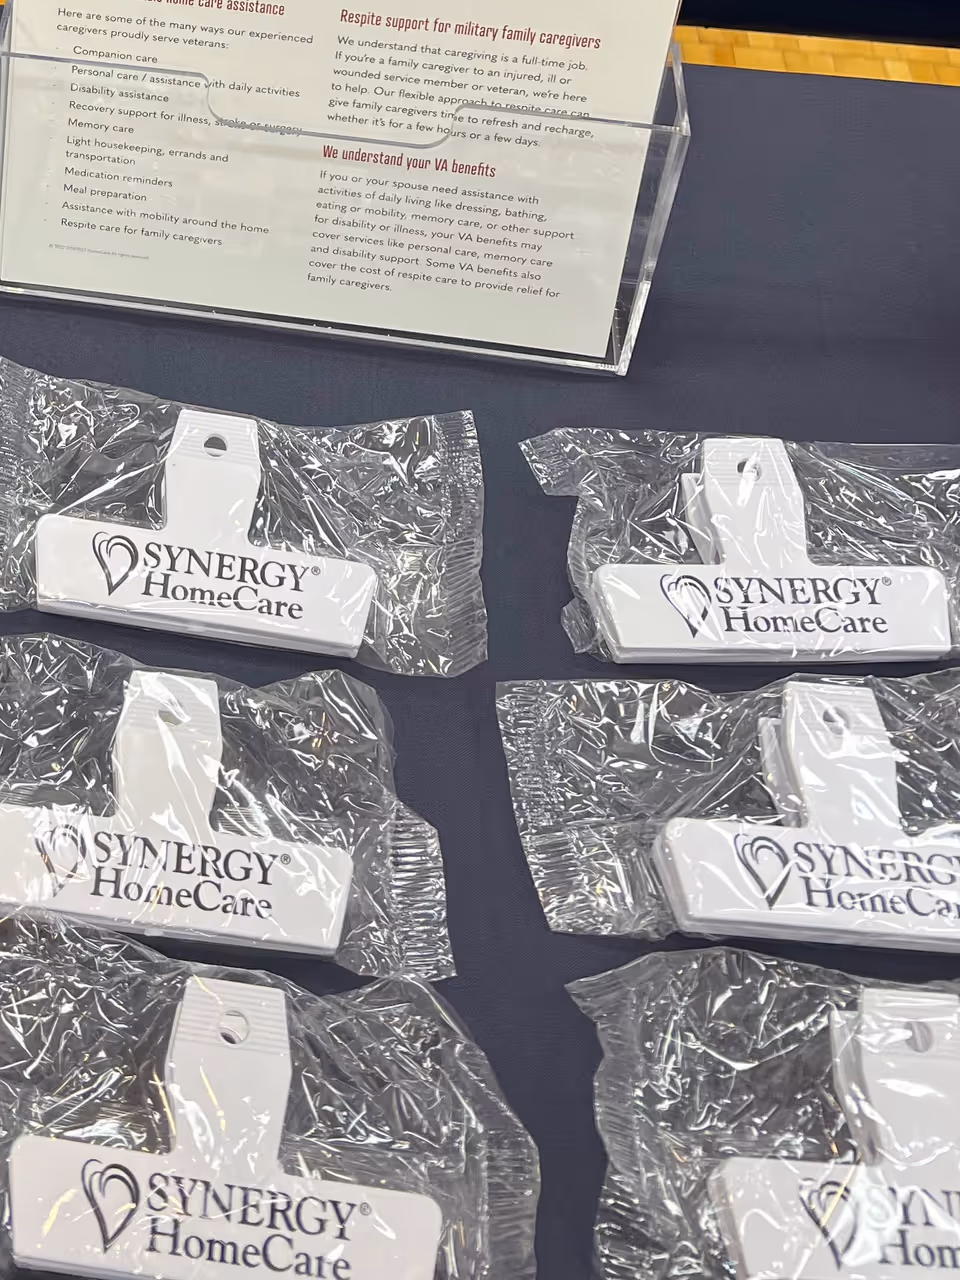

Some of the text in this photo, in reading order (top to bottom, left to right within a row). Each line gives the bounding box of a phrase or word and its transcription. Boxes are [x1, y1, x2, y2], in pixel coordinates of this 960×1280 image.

[56, 24, 108, 36] caregivers
[110, 30, 150, 42] proudly
[152, 35, 180, 44] serve
[57, 7, 314, 44] Here are some of the many ways our experienced
[340, 8, 601, 50] Respite support for military family caregivers
[73, 45, 158, 64] Companion care
[337, 35, 355, 46] We
[357, 39, 418, 53] understand
[420, 44, 442, 56] that
[444, 49, 498, 64] caregiving
[500, 53, 509, 63] is
[521, 54, 565, 69] full-time
[70, 82, 169, 103] Disability assistance
[333, 68, 381, 80] wounded
[383, 74, 421, 85] service
[423, 78, 469, 89] member
[562, 91, 588, 103] here
[69, 100, 115, 116] Recovery
[117, 108, 157, 119] support
[160, 110, 175, 120] for
[68, 117, 134, 134] Memory care
[65, 150, 136, 165] transportation
[66, 135, 91, 147] Light
[168, 149, 207, 160] errands
[209, 154, 229, 163] and
[323, 144, 496, 178] We understand your VA benefits
[64, 166, 173, 188] Medication reminders
[63, 183, 147, 202] Meal preparation
[61, 217, 223, 246] Respite care for family caregivers
[307, 272, 337, 286] family
[141, 571, 304, 619] HomeCare
[719, 606, 889, 634] HomeCare
[793, 841, 960, 886] SYNERG
[90, 866, 273, 919] HomeCare
[146, 1214, 352, 1280] HomeCare
